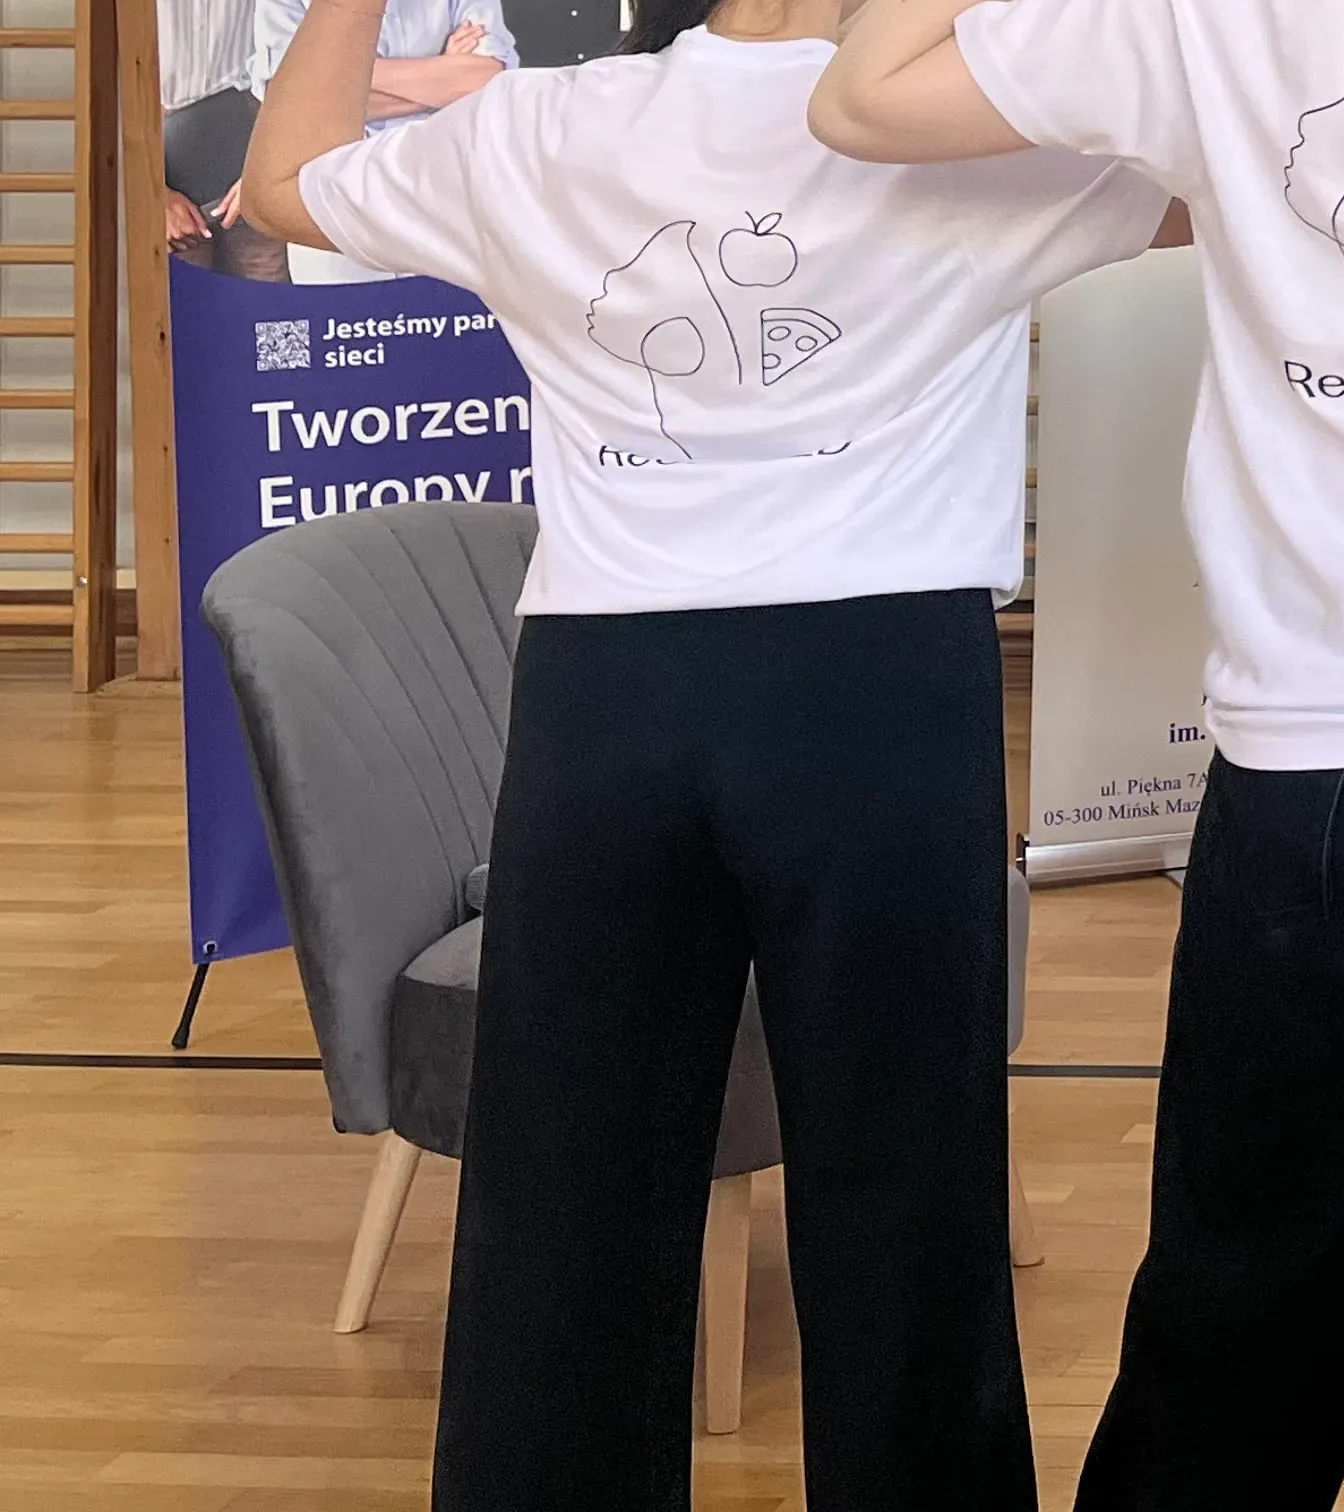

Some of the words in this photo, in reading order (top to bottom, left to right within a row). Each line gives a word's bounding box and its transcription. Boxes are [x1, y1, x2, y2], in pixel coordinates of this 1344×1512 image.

[322, 313, 448, 341] Jesteśmy
[324, 343, 386, 369] sieci
[251, 393, 531, 453] Tworzen
[1169, 722, 1207, 744] im.
[1100, 780, 1122, 797] ul.
[1127, 775, 1182, 797] Piękna
[1043, 806, 1103, 827] 05-300
[1108, 801, 1160, 821] Mińsk
